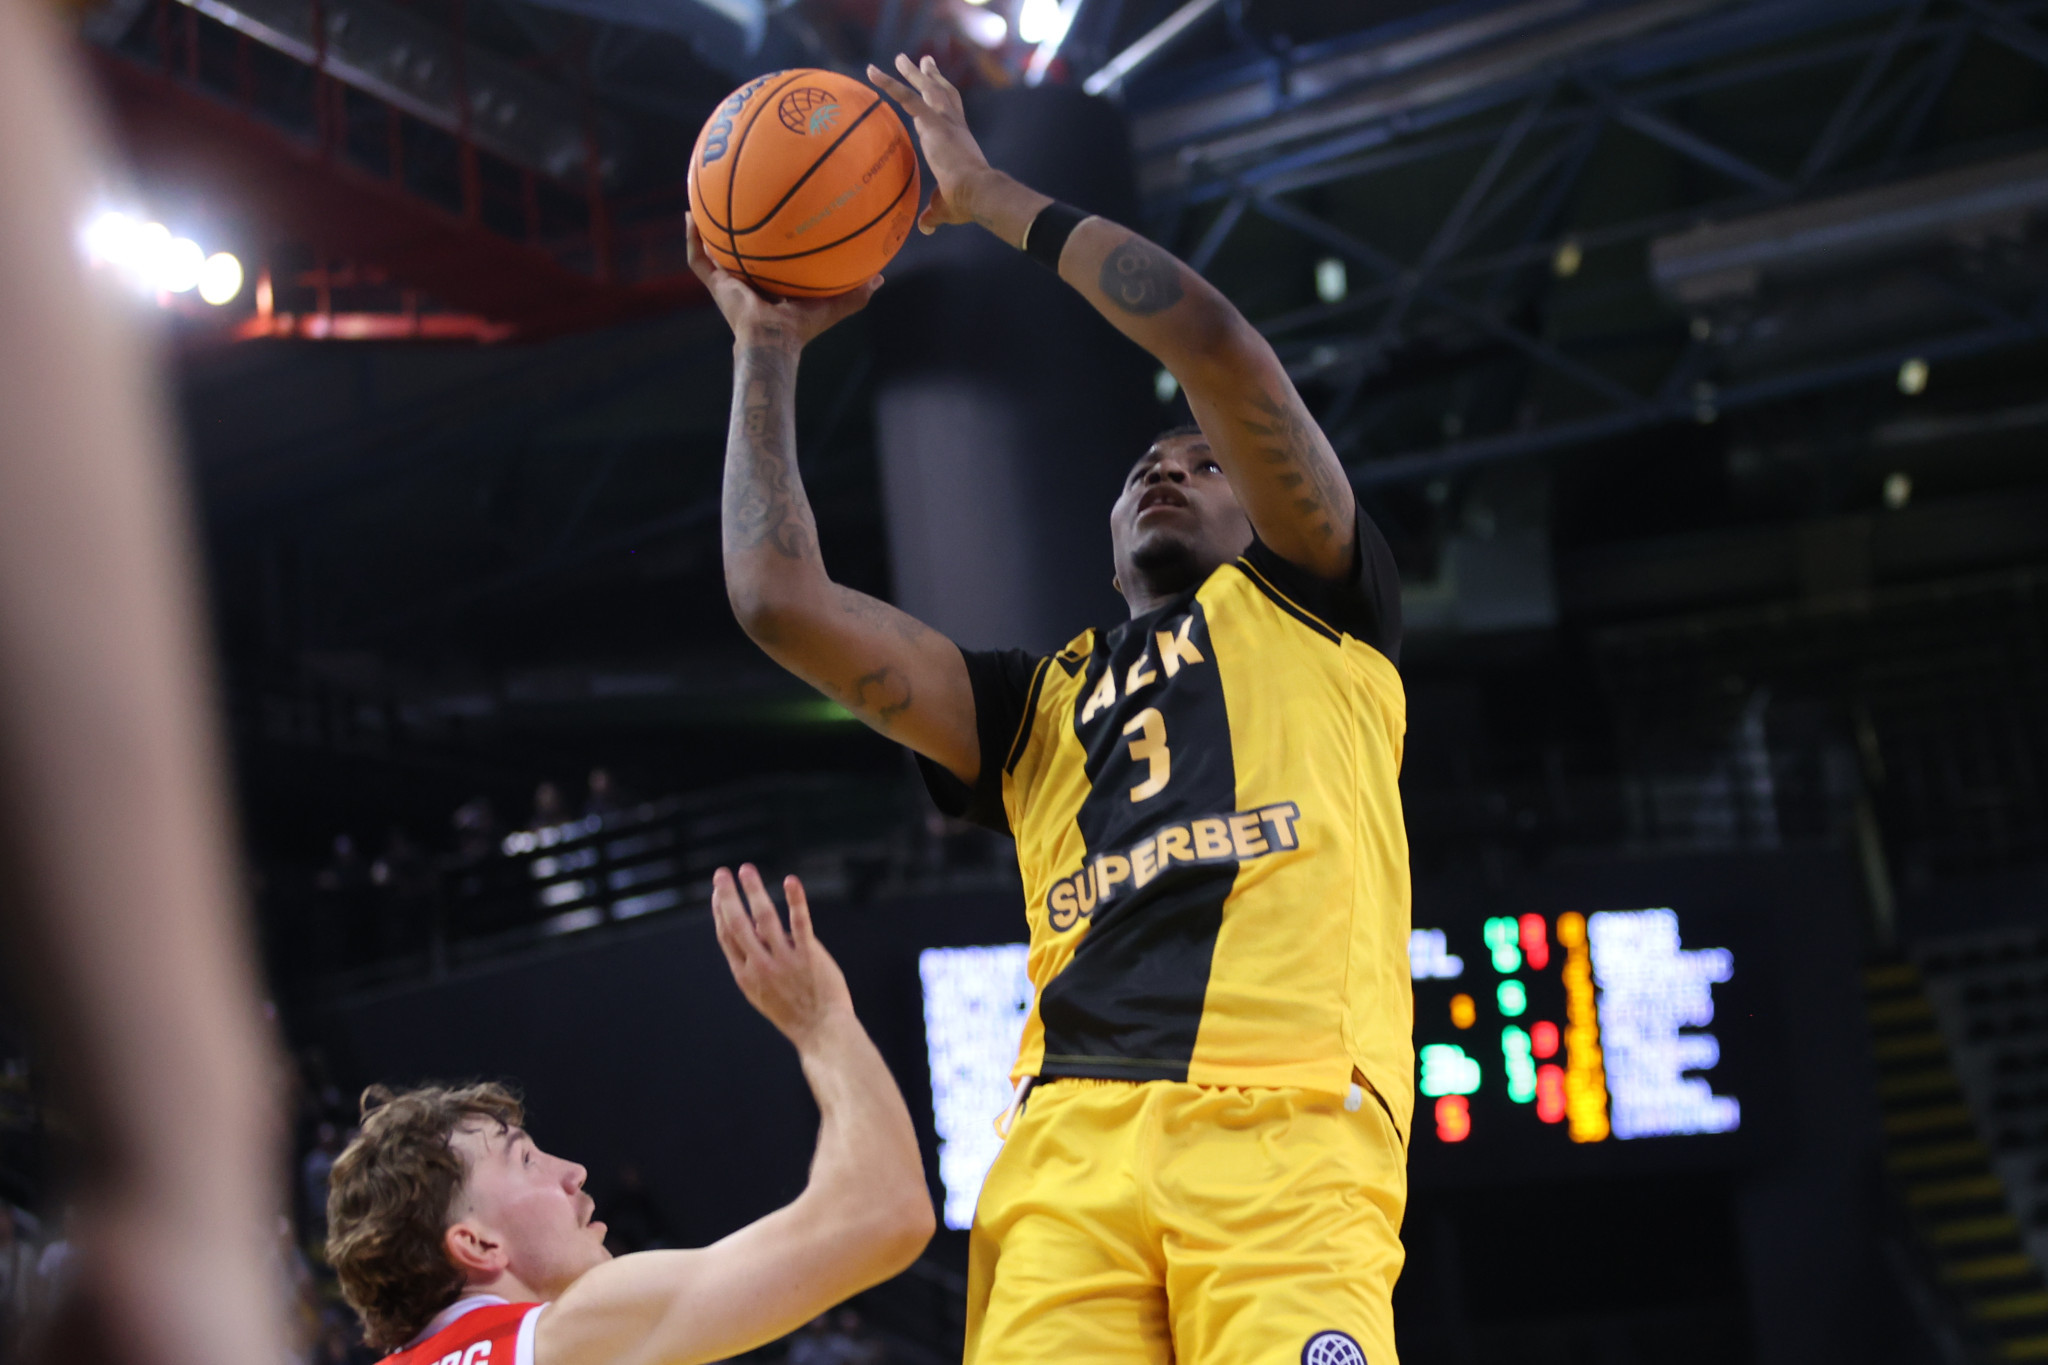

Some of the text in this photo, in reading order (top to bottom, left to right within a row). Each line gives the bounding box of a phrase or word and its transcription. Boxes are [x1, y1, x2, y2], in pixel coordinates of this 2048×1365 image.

[702, 71, 783, 168] Wil
[1081, 614, 1205, 725] AEK
[1122, 707, 1170, 803] 3
[1049, 802, 1300, 932] SUPERBET
